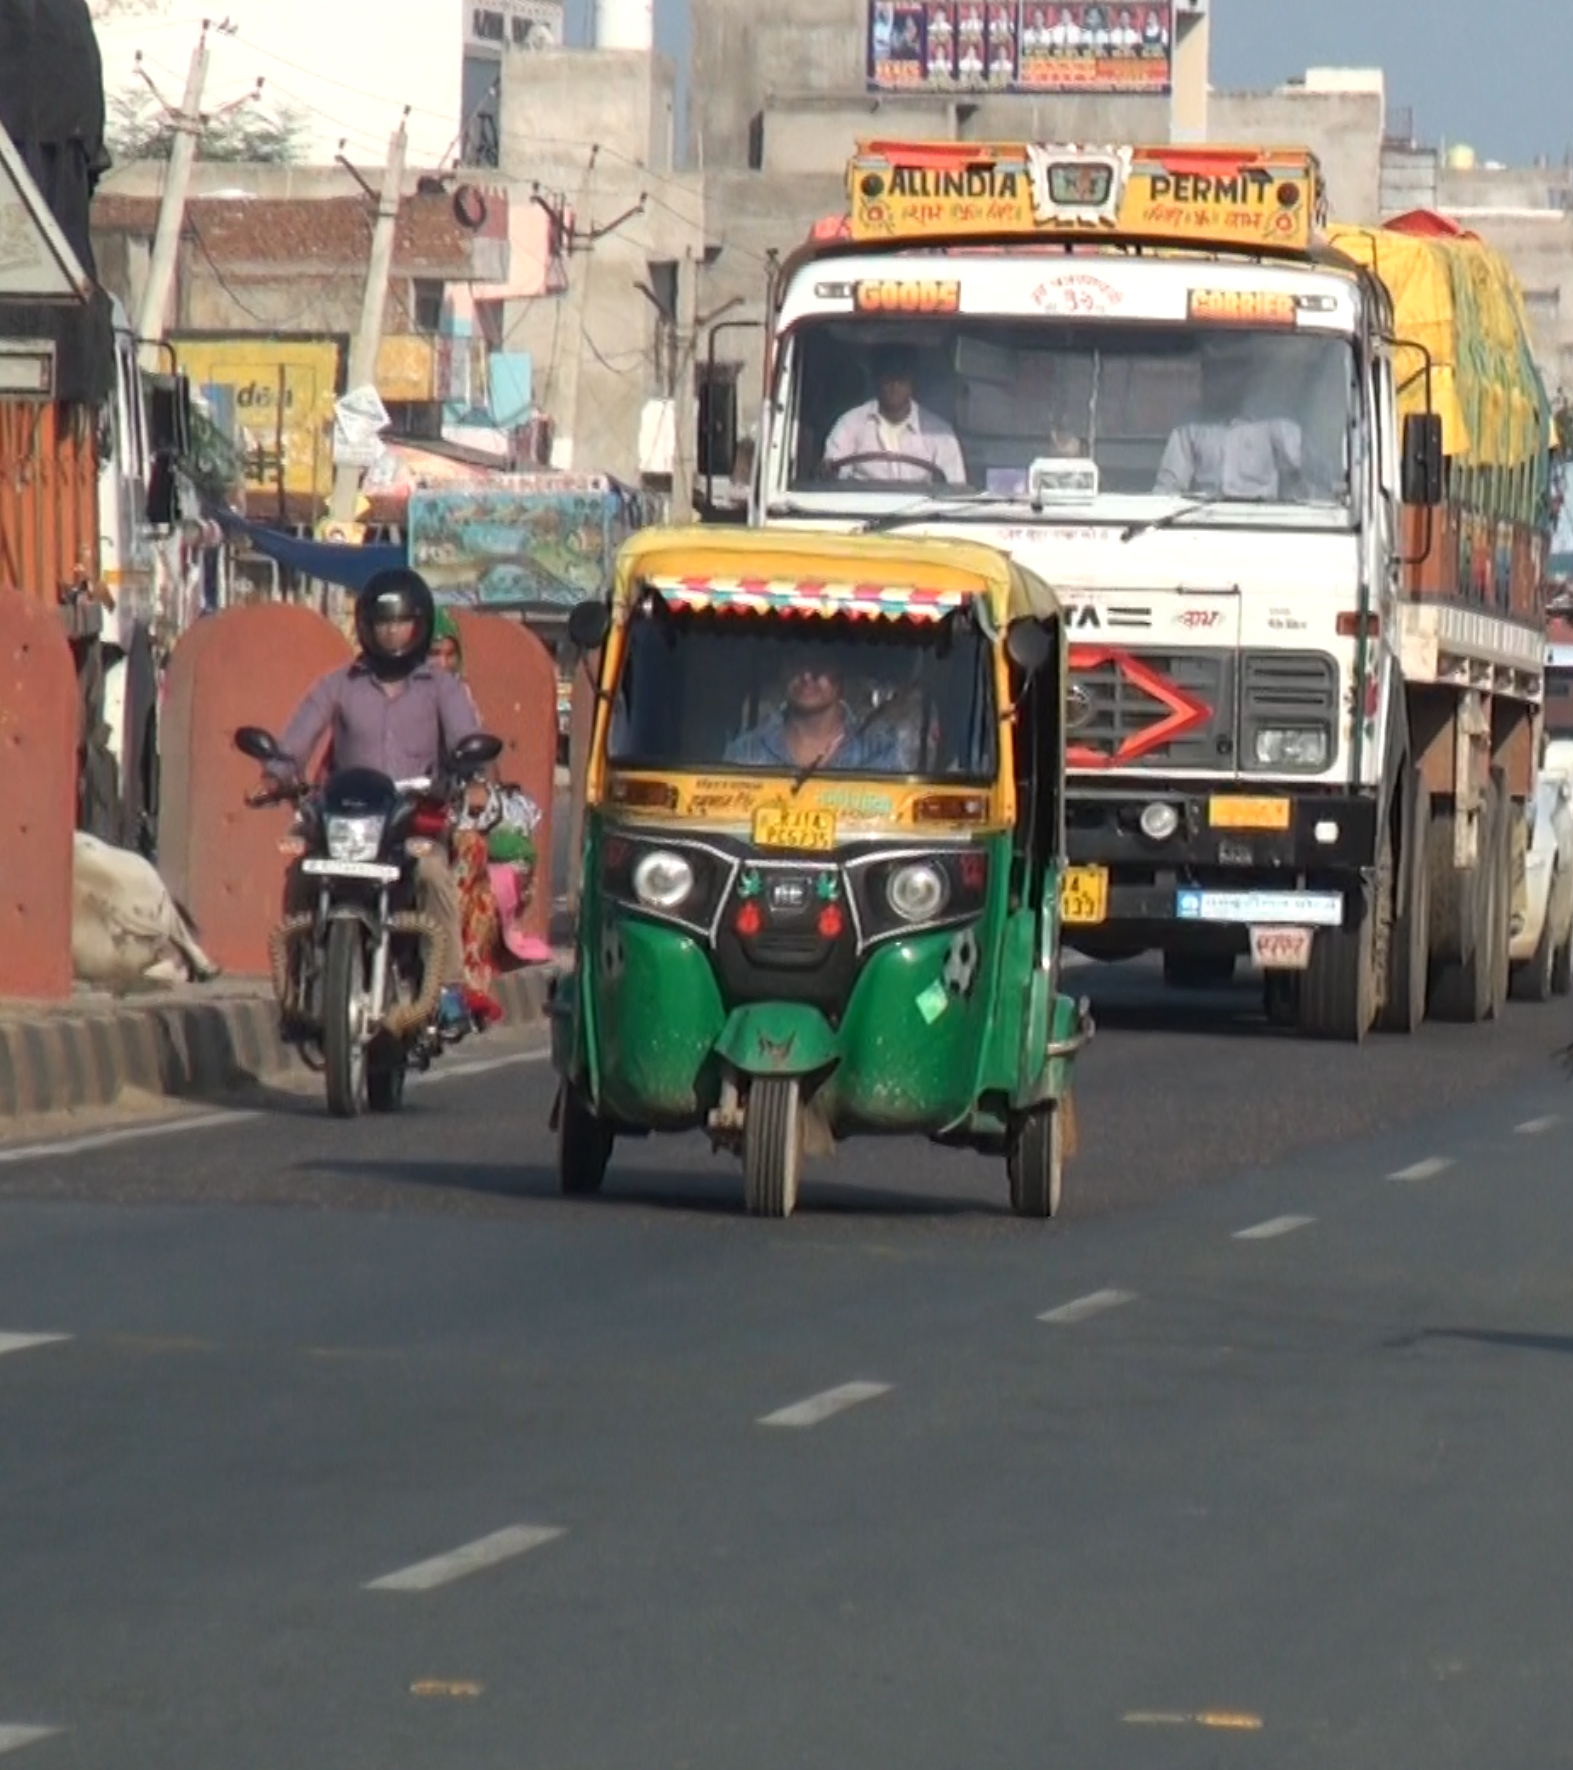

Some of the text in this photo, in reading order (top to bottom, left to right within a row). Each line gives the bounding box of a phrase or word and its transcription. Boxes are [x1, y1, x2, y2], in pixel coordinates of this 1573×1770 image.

[1149, 174, 1269, 204] PERMIT
[860, 280, 956, 312] GOODS
[1063, 604, 1100, 628] TA
